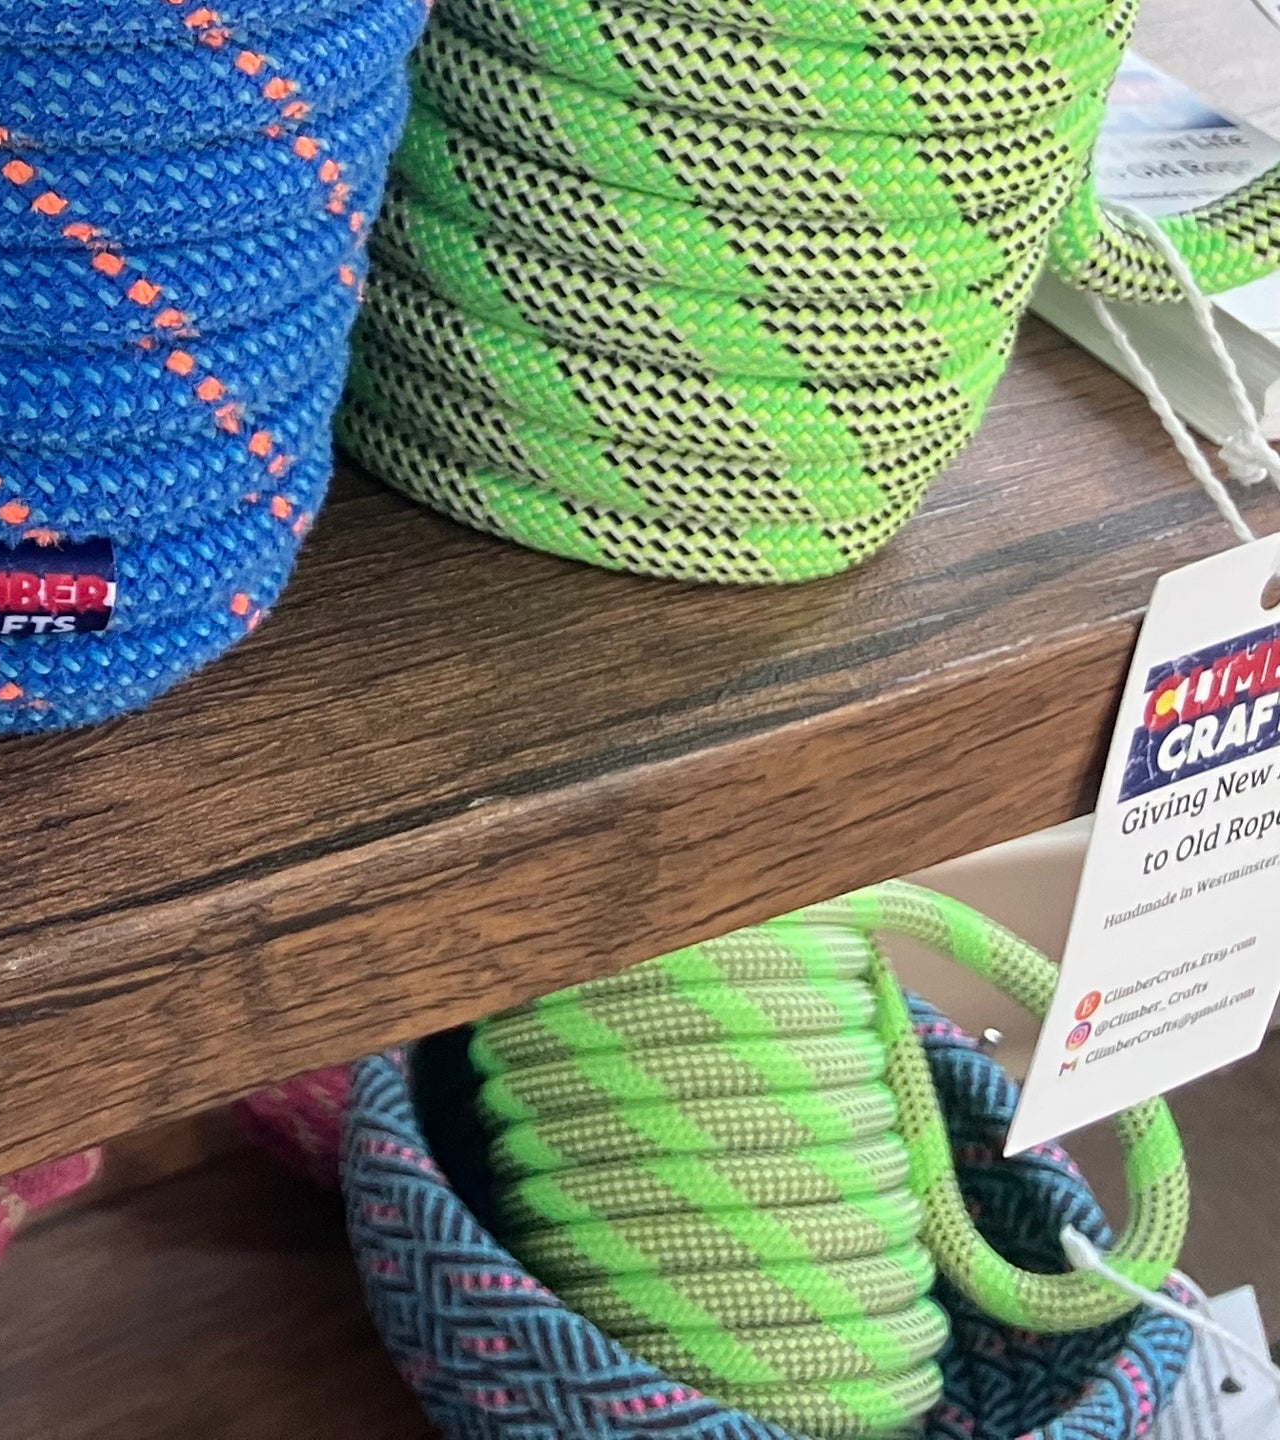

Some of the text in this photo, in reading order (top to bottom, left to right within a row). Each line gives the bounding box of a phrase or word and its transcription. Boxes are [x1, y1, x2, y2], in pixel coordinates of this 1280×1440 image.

[1144, 636, 1280, 733] CLIM
[1158, 692, 1280, 772] CRAF
[1121, 764, 1273, 835] Giving New
[1143, 849, 1168, 875] to
[1176, 823, 1221, 862] Old
[1103, 891, 1177, 930] Handmade
[1179, 886, 1193, 900] in
[1103, 936, 1257, 1005] ClimberCrafts.Etsy.com
[1085, 987, 1255, 1064] ClimberCrafts@gmail.com
